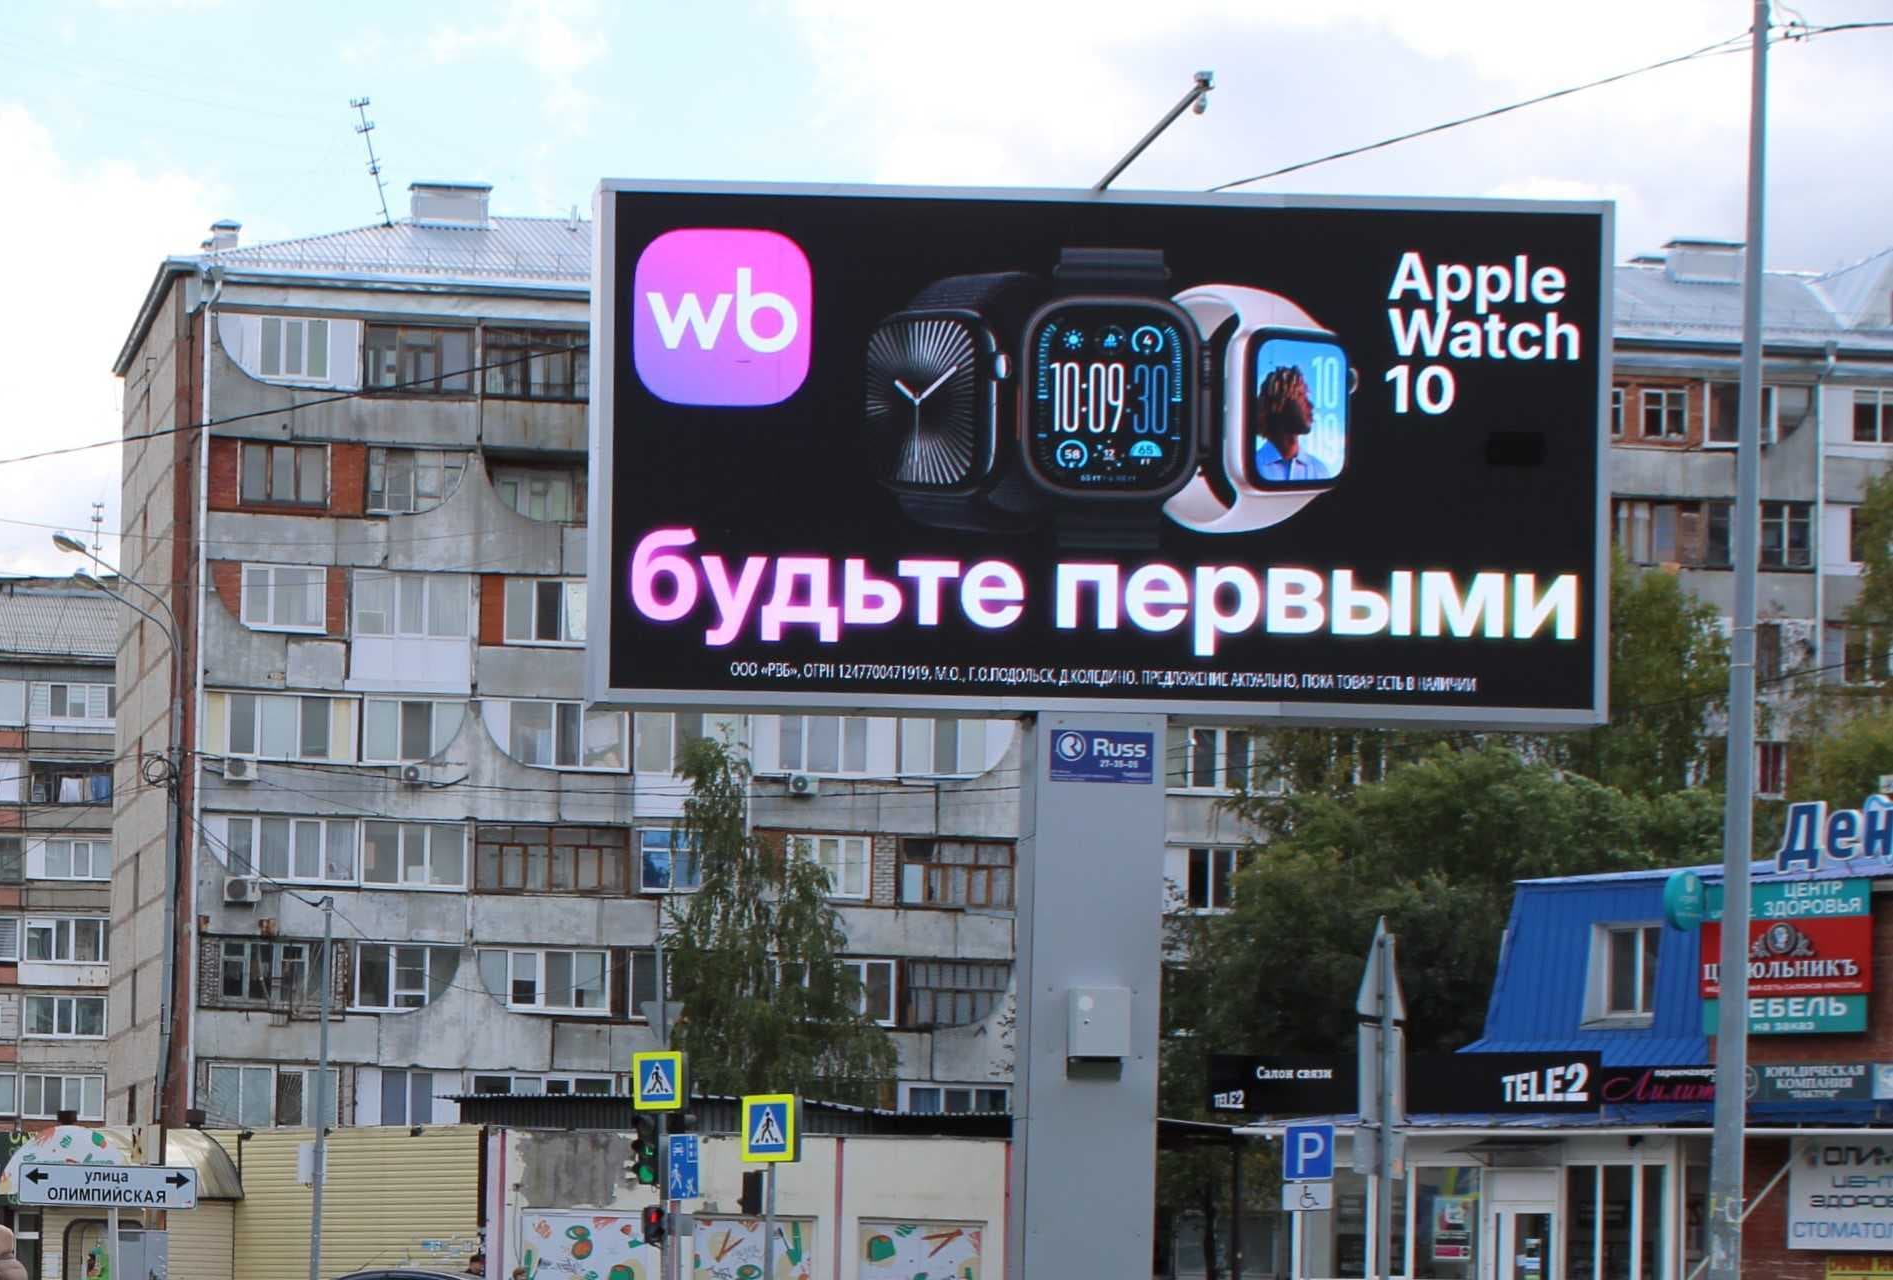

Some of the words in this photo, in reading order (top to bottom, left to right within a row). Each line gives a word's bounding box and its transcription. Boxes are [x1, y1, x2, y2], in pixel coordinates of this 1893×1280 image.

[1388, 251, 1566, 312] Apple
[646, 268, 799, 354] wb
[1388, 305, 1580, 360] Watch
[1384, 366, 1455, 414] 10
[630, 528, 1025, 647] будьте
[1057, 561, 1579, 656] первыми
[730, 662, 758, 677] ООО
[803, 663, 835, 678] ОГРН
[1301, 673, 1334, 688] ПОКА
[1336, 674, 1374, 689] ТОВАР
[1093, 738, 1147, 758] Russ
[1784, 881, 1844, 899] ЦЕНТР
[1764, 897, 1863, 918] ЗДОРОВЬЯ
[1704, 959, 1859, 982] ЦЮЛЬНИКЪ
[1746, 996, 1848, 1018] ЕБЕЛЬ
[1257, 1066, 1294, 1080] Салон
[1297, 1067, 1332, 1080] связи
[1765, 1065, 1865, 1078] ЮРИДИЧЕСКАЯ
[1502, 1062, 1589, 1103] TELE2
[1776, 1077, 1853, 1089] КОМПАНИЯ
[1213, 1089, 1245, 1109] TELE2
[85, 1170, 128, 1184] улица
[47, 1186, 167, 1205] ОЛИМПИЙСКАЯ
